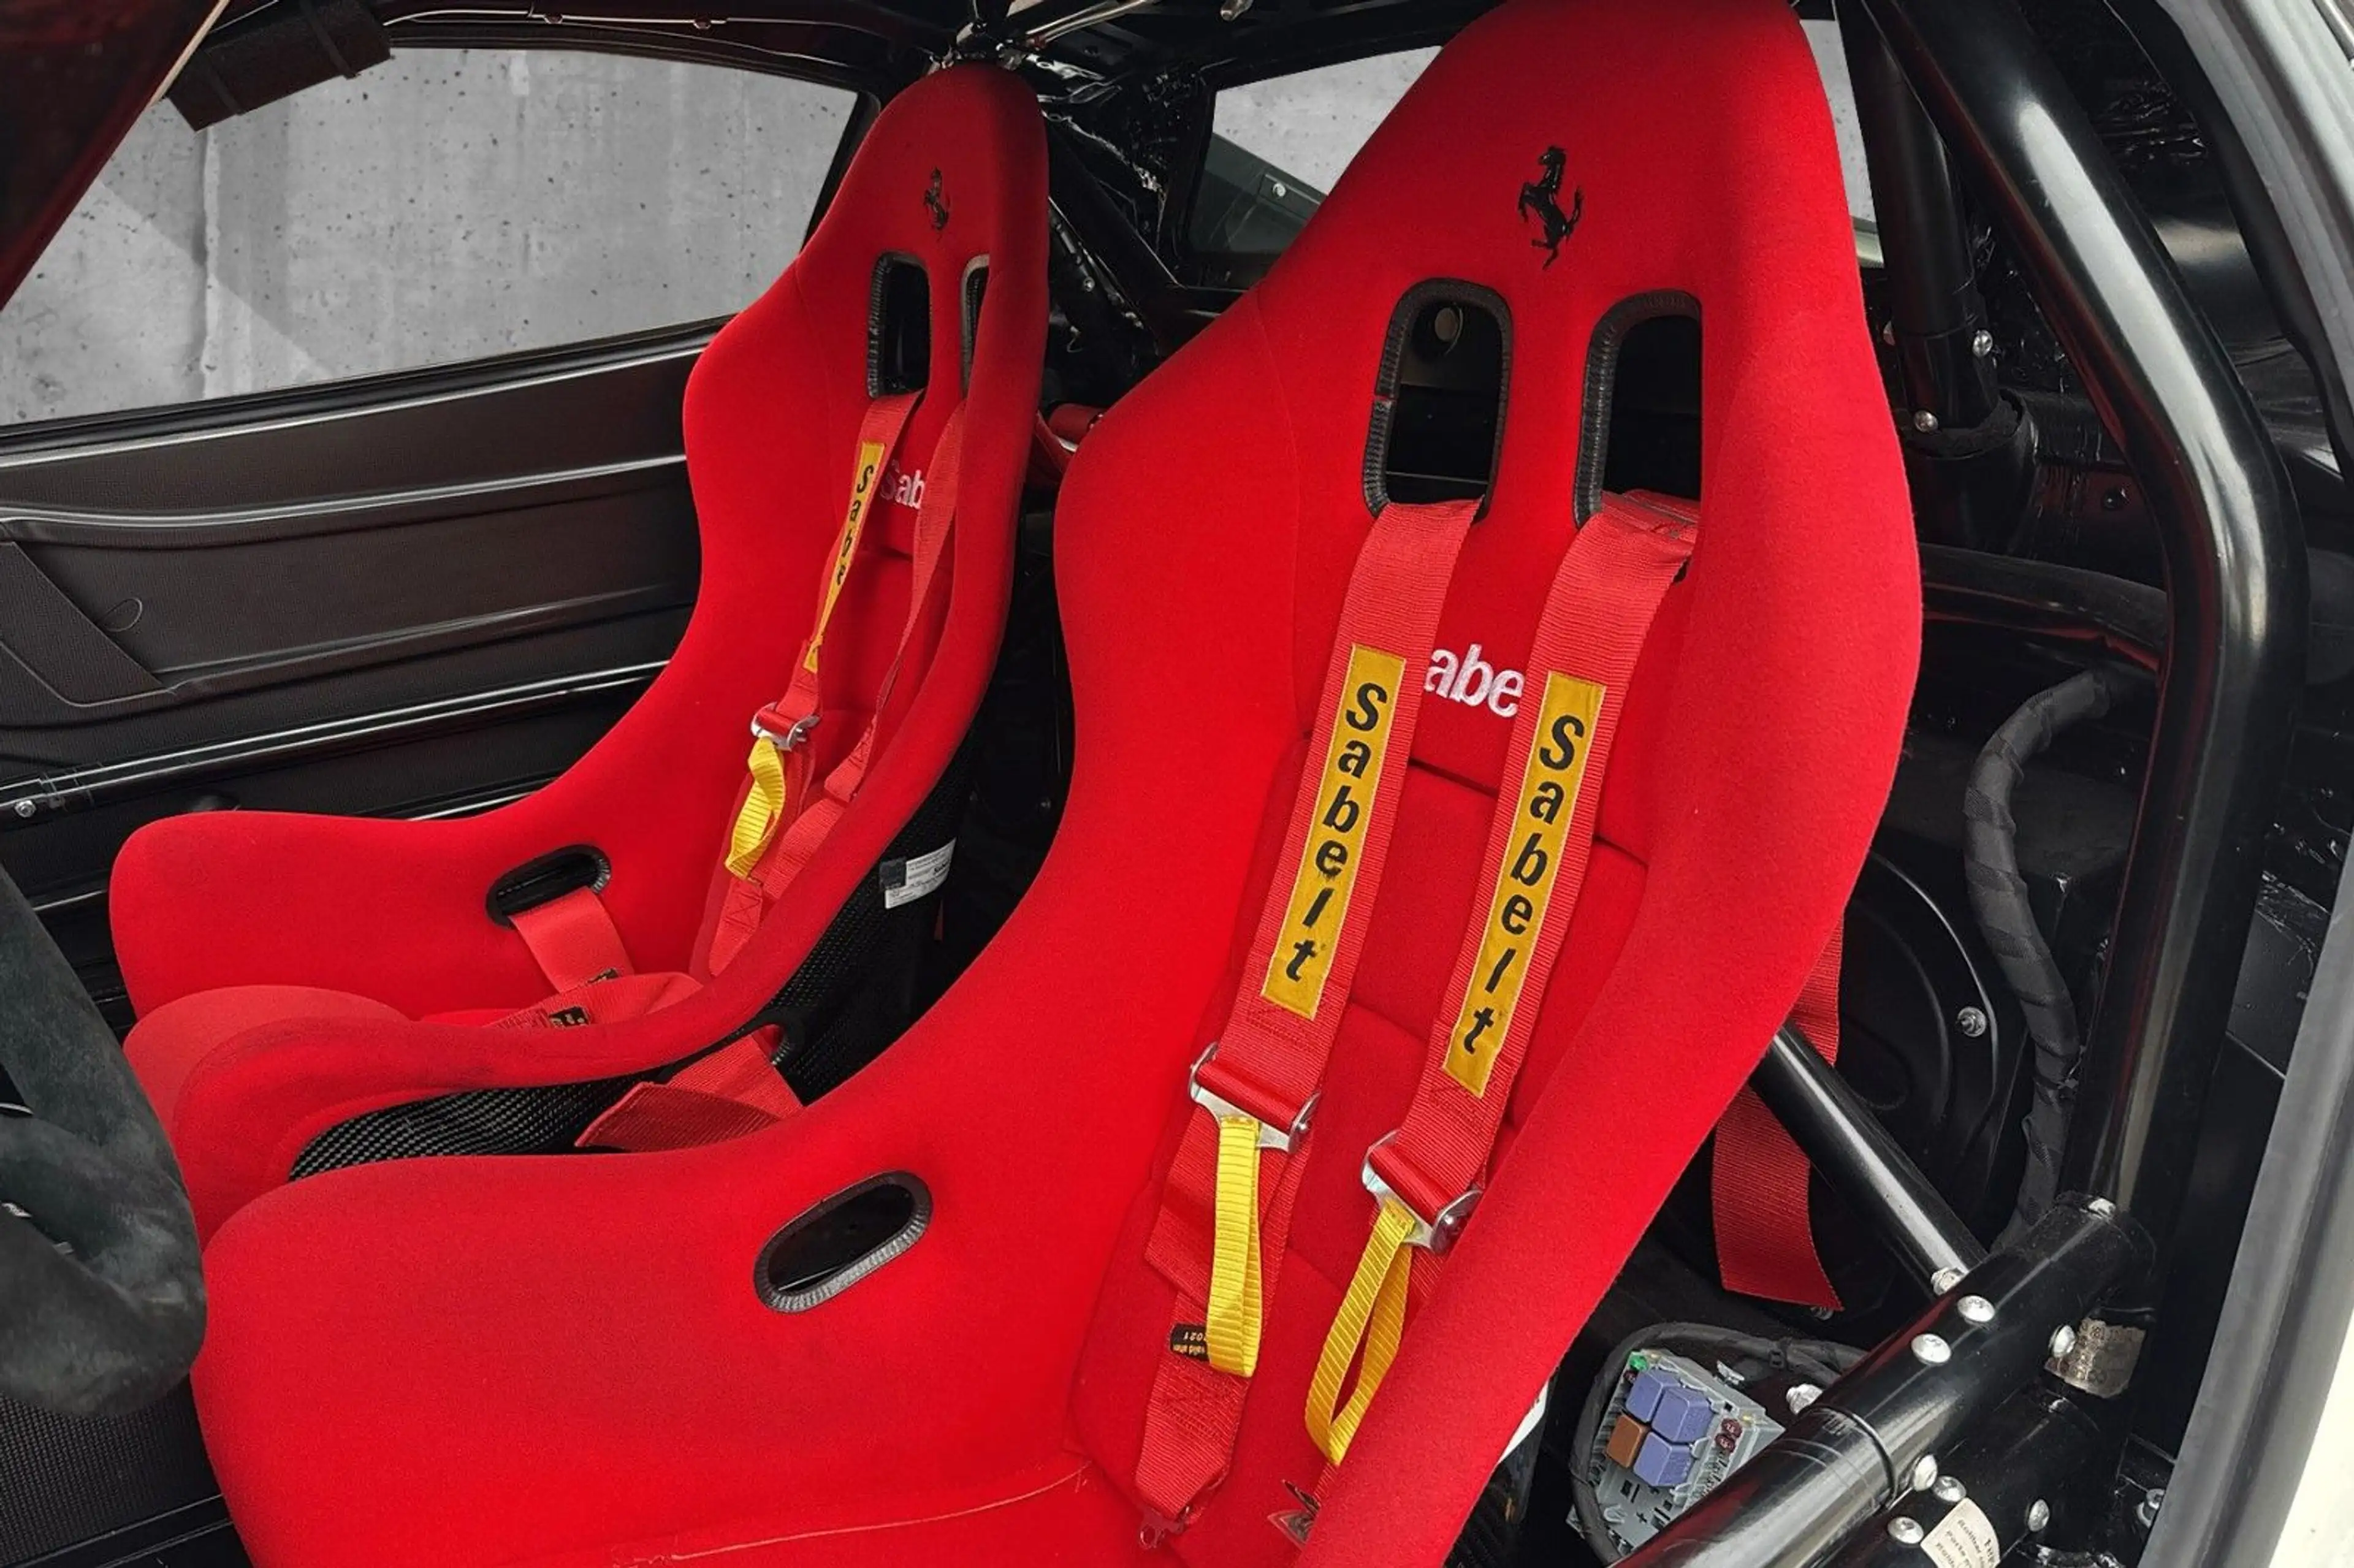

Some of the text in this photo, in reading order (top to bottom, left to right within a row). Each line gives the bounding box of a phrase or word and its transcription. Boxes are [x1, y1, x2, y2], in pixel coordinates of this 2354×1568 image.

[1423, 644, 1525, 718] abe
[1286, 682, 1387, 982] Sabelt
[1463, 715, 1585, 1054] Sabelt
[1183, 1331, 1204, 1342] 021
